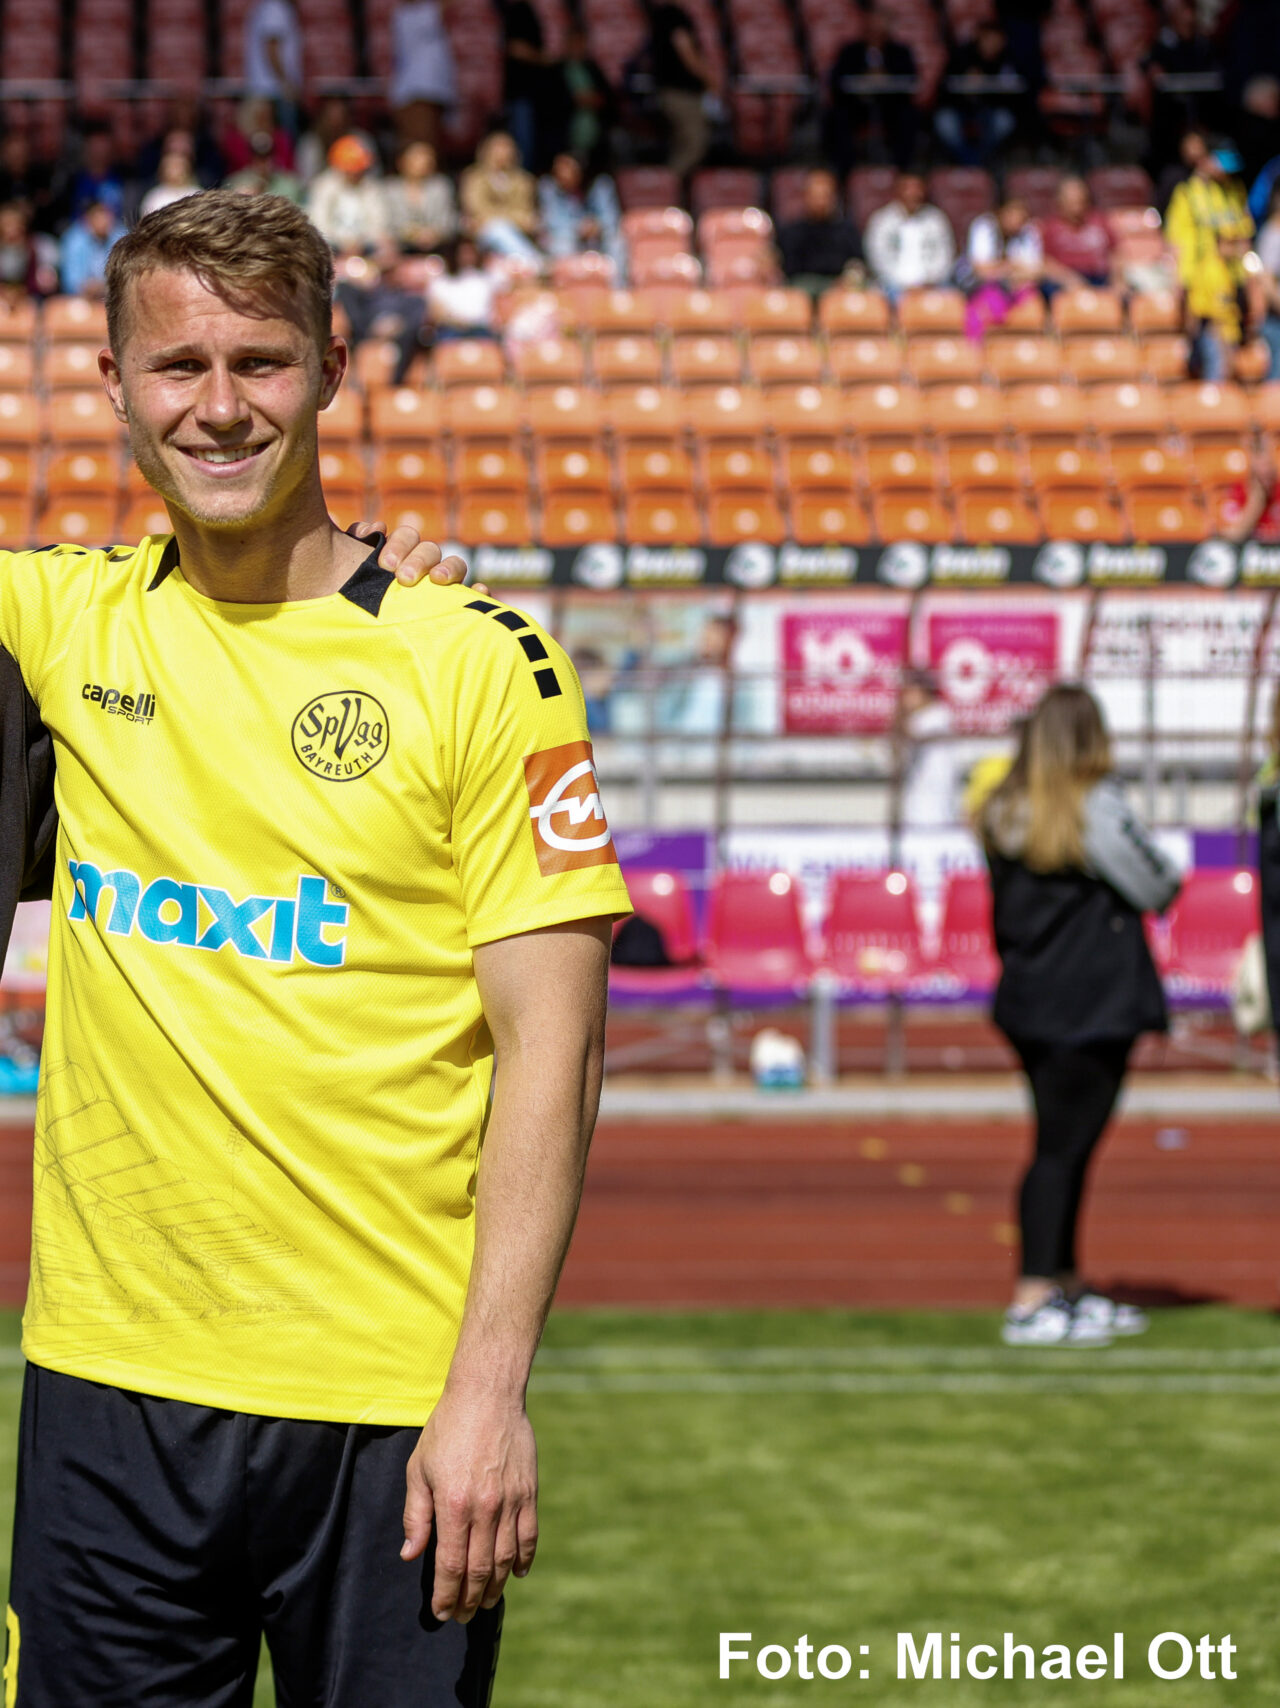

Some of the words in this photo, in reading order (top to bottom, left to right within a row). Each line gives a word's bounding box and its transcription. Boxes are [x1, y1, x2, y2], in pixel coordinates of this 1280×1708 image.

[81, 683, 156, 718] capelli
[107, 705, 154, 726] SPORT
[300, 744, 373, 776] BAYREUTH
[67, 858, 350, 967] maxit
